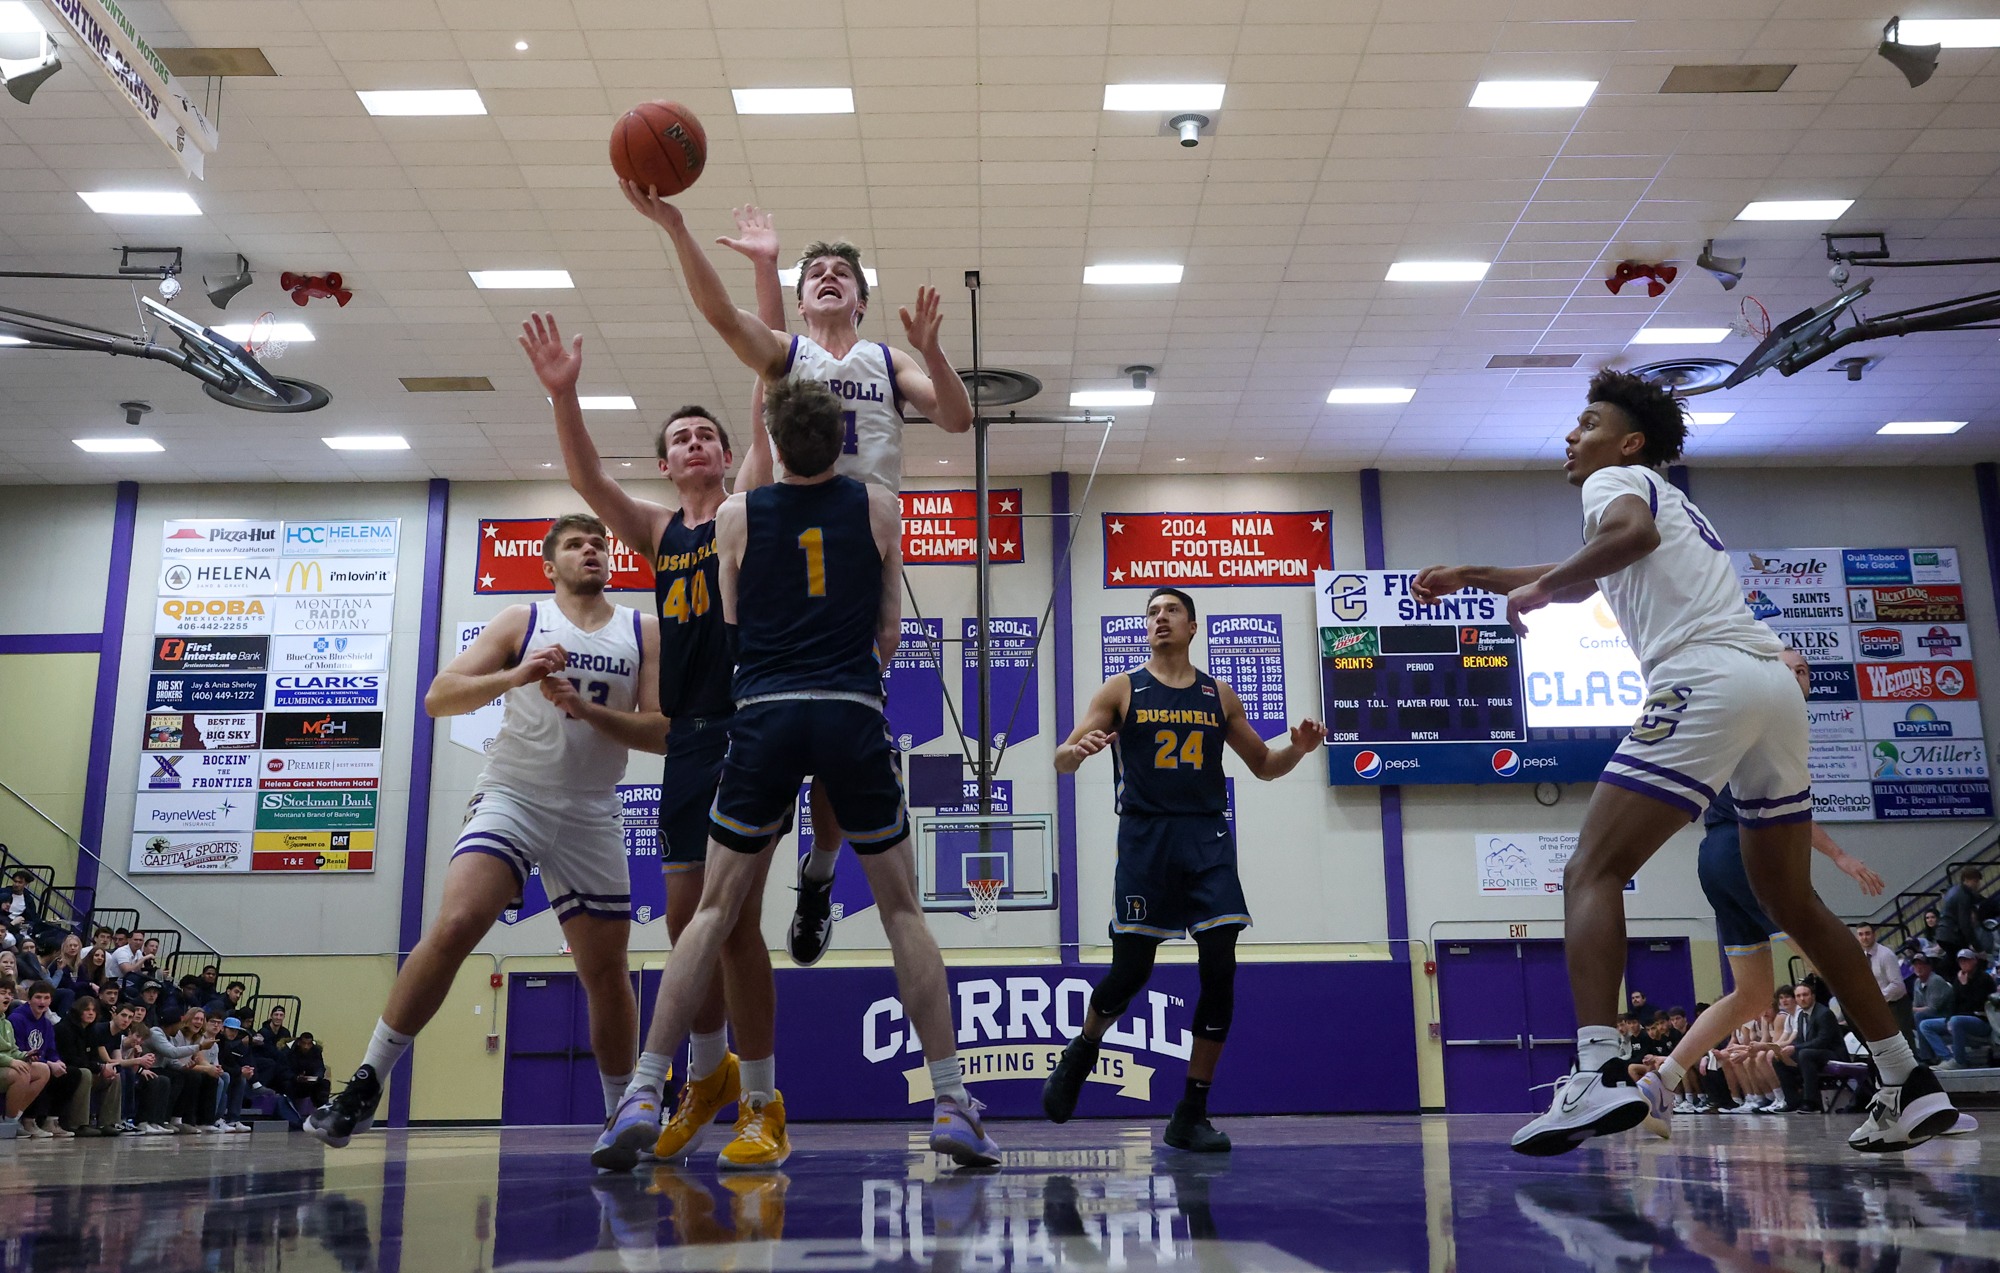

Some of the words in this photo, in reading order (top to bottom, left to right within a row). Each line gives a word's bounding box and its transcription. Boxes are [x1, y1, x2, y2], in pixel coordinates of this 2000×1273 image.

[55, 0, 110, 61] GHTING
[100, 0, 135, 42] UNTAIN
[137, 36, 169, 85] MOTORS
[824, 379, 883, 402] ROLL
[913, 497, 953, 514] NAIA
[330, 527, 392, 537] HELENA
[901, 520, 955, 535] TBALL
[1161, 520, 1206, 536] 2004
[1232, 519, 1273, 535] NAIA
[494, 540, 543, 557] NATIO
[1172, 540, 1264, 556] FOOTBALL
[798, 526, 826, 597] 1
[198, 567, 271, 580] HELENA
[1131, 561, 1213, 577] NATIONAL
[1219, 559, 1307, 576] CHAMPION
[1761, 559, 1827, 578] Eagle
[663, 570, 710, 624] 40
[1793, 593, 1830, 603] SAINTS
[1875, 590, 1905, 601] LUCKY
[1906, 588, 1928, 599] DOG
[295, 599, 372, 609] MONTANA
[1399, 598, 1494, 620] SAINTS
[163, 601, 265, 621] QDOBA
[310, 610, 356, 619] RADIO
[1783, 607, 1843, 618] HIGHLIGHTS
[295, 620, 369, 630] COMPANY
[968, 621, 1031, 637] CRROLL
[1212, 618, 1277, 634] CARROLL
[1234, 636, 1281, 644] BASKETBALL
[1580, 636, 1630, 649] Comfo
[186, 643, 212, 651] First
[184, 652, 237, 660] Interstate
[238, 652, 260, 660] Bank
[1463, 656, 1508, 668] BEACONS
[565, 652, 630, 676] RROLL
[1335, 657, 1373, 669] SAINTS
[1407, 663, 1434, 671] PERIOD
[157, 681, 169, 690] BIG
[170, 681, 183, 690] SKY
[191, 682, 203, 690] Jay
[232, 681, 257, 689] Sherley
[276, 677, 378, 688] CLARK'S
[156, 691, 183, 699] BROKERS
[1527, 671, 1642, 707] CLAS
[192, 692, 213, 700] (406)
[1334, 700, 1359, 708] FOULS
[1367, 700, 1388, 708] T.O.L.
[1397, 699, 1427, 708] PLAYER
[1430, 699, 1450, 707] FOUL
[1457, 699, 1479, 707] T.O.L.
[1488, 698, 1512, 707] FOULS
[1136, 709, 1219, 727] BUSHNELL
[1897, 724, 1927, 732] Days
[206, 731, 225, 739] BIG
[228, 731, 250, 739] SKY
[1334, 732, 1359, 741] SCORE
[1412, 732, 1439, 740] MATCH
[1490, 731, 1516, 739] SCORE
[1154, 730, 1204, 770] 24
[1901, 745, 1981, 763] Miller's
[203, 755, 251, 765] ROCKIN'
[288, 759, 330, 770] PREMIER
[1906, 767, 1984, 775] CROSSING
[192, 778, 252, 787] FRONTIER
[1874, 785, 1903, 794] HELENA
[1905, 784, 1959, 794] CHIROPRACTIC
[1960, 783, 1989, 793] CENTER
[283, 794, 337, 806] Stockman
[342, 794, 371, 806] Bank
[1912, 796, 1937, 805] Bryan
[152, 810, 216, 823] PayneWest
[635, 829, 656, 837] 2008
[332, 836, 349, 845] CAT
[144, 850, 193, 865] CAPITAL
[196, 843, 237, 856] SPORTS
[1483, 879, 1537, 887] FRONTIER
[1510, 925, 1527, 938] EXIT
